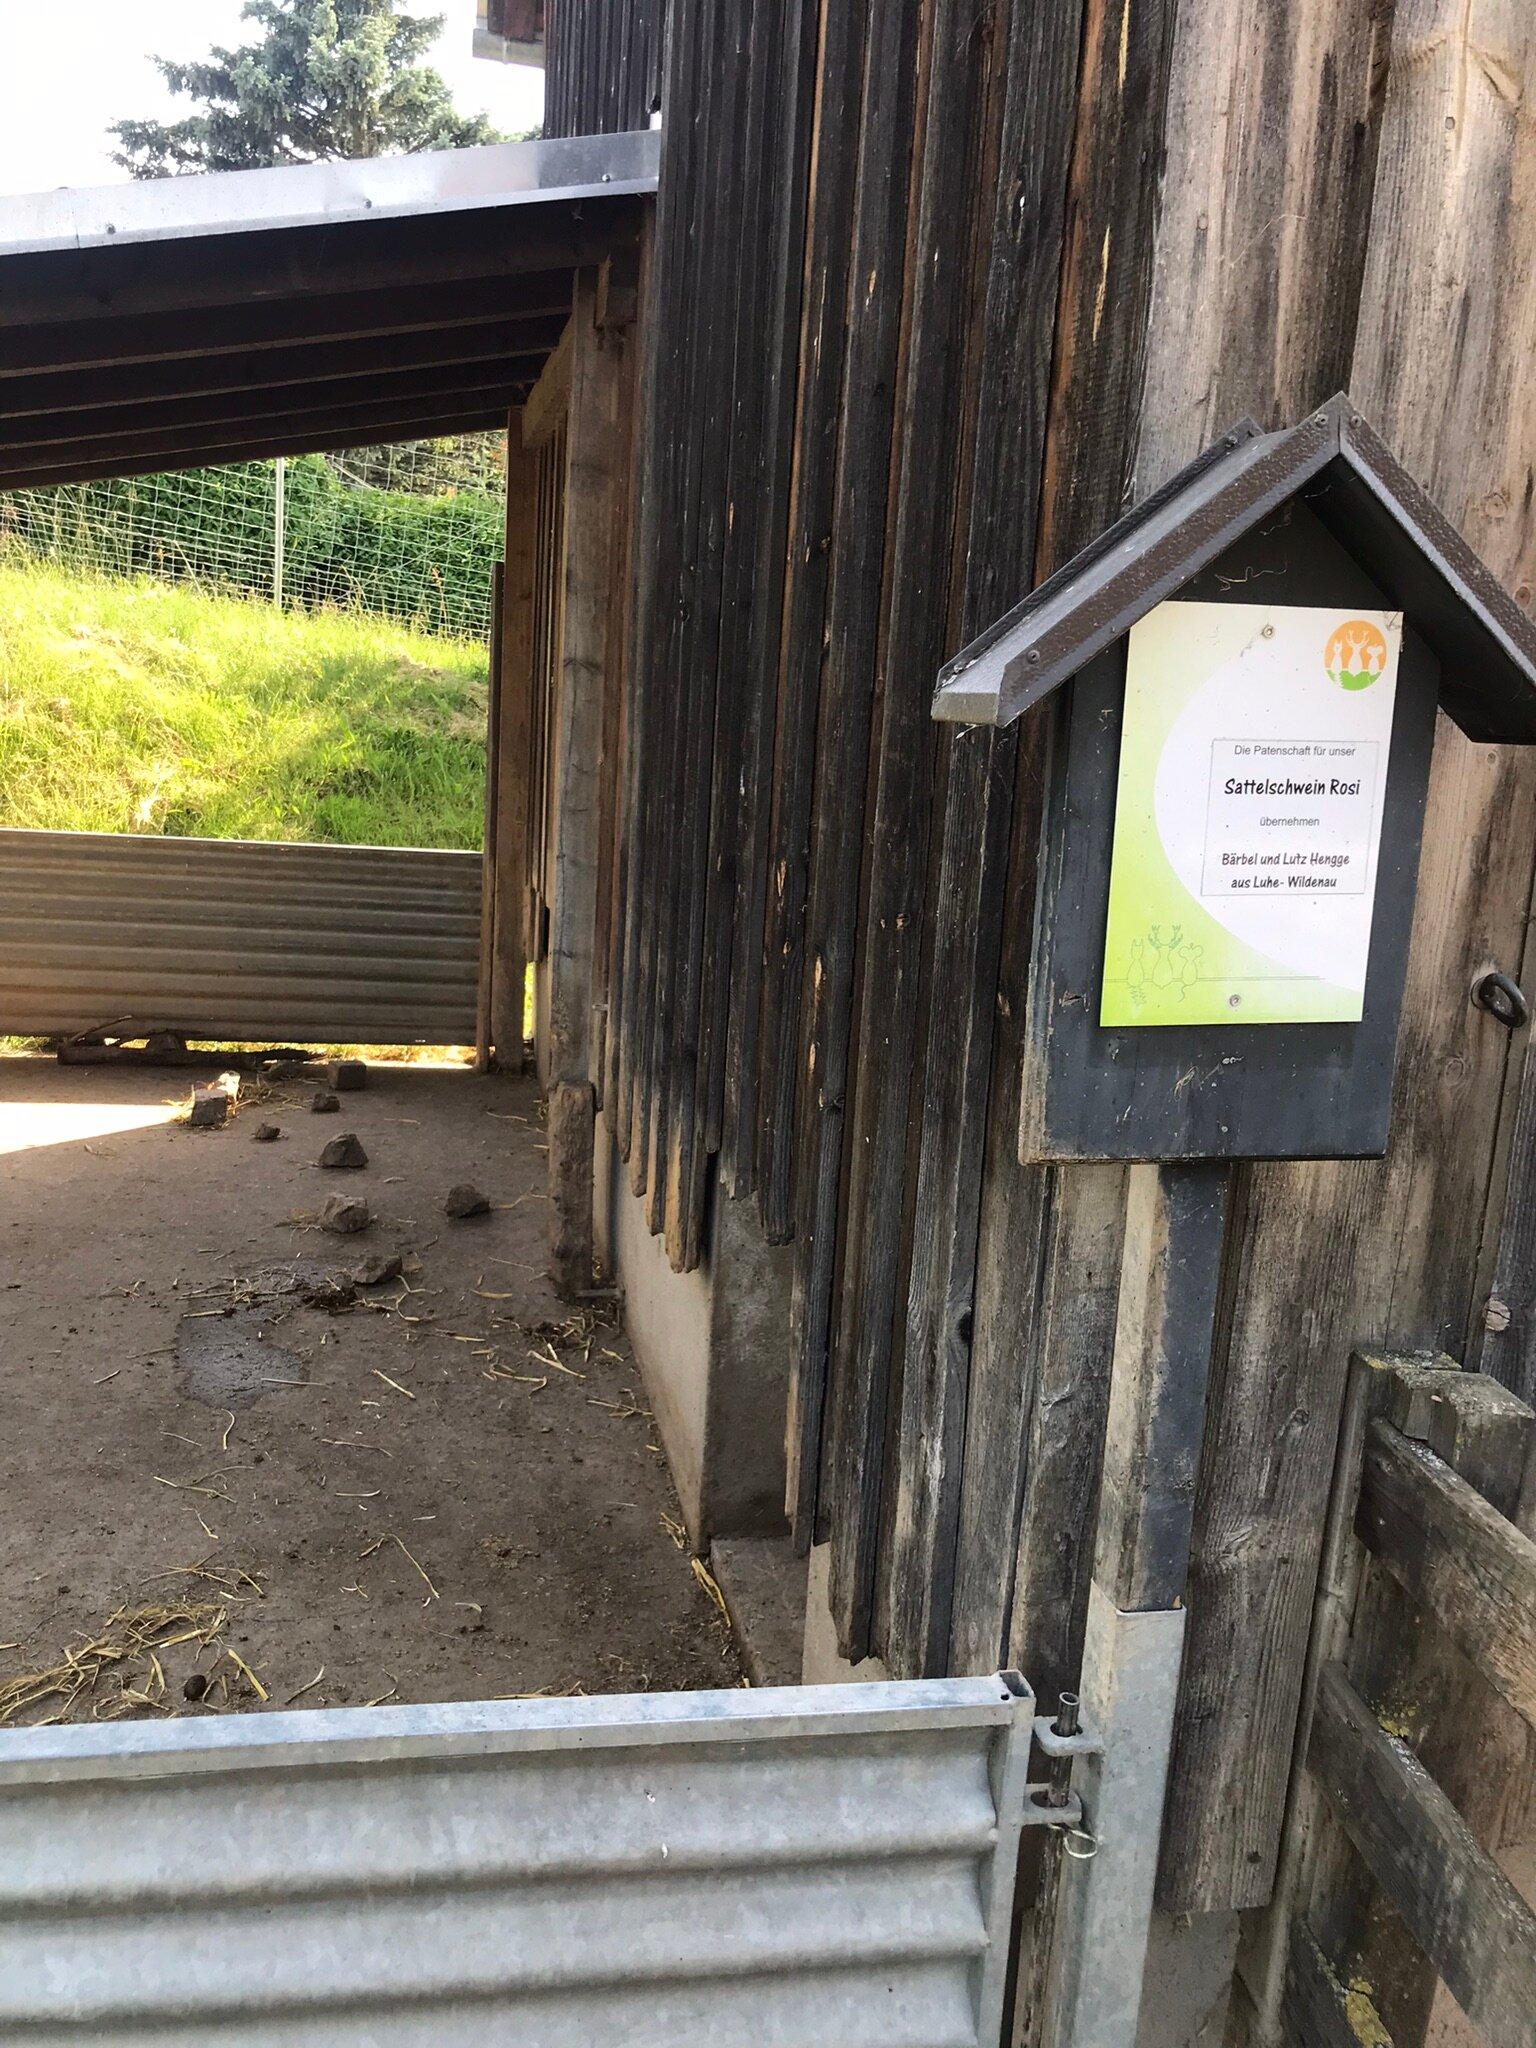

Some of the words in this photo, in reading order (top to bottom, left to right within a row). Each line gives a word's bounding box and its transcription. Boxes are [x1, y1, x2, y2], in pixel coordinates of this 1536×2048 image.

[1234, 745, 1250, 755] Die
[1253, 745, 1311, 756] Patenschaft
[1313, 745, 1326, 756] für
[1328, 748, 1355, 756] unser
[1224, 778, 1325, 795] Sattelschwein
[1330, 778, 1361, 795] Rosi
[1260, 817, 1320, 827] übernehmen
[1222, 853, 1258, 865] Bärbel
[1260, 853, 1280, 865] und
[1283, 853, 1307, 865] Lutz
[1310, 852, 1350, 868] Hengge
[1231, 878, 1250, 888] aus
[1253, 876, 1284, 888] Luhe-
[1288, 876, 1337, 888] Wildenau
